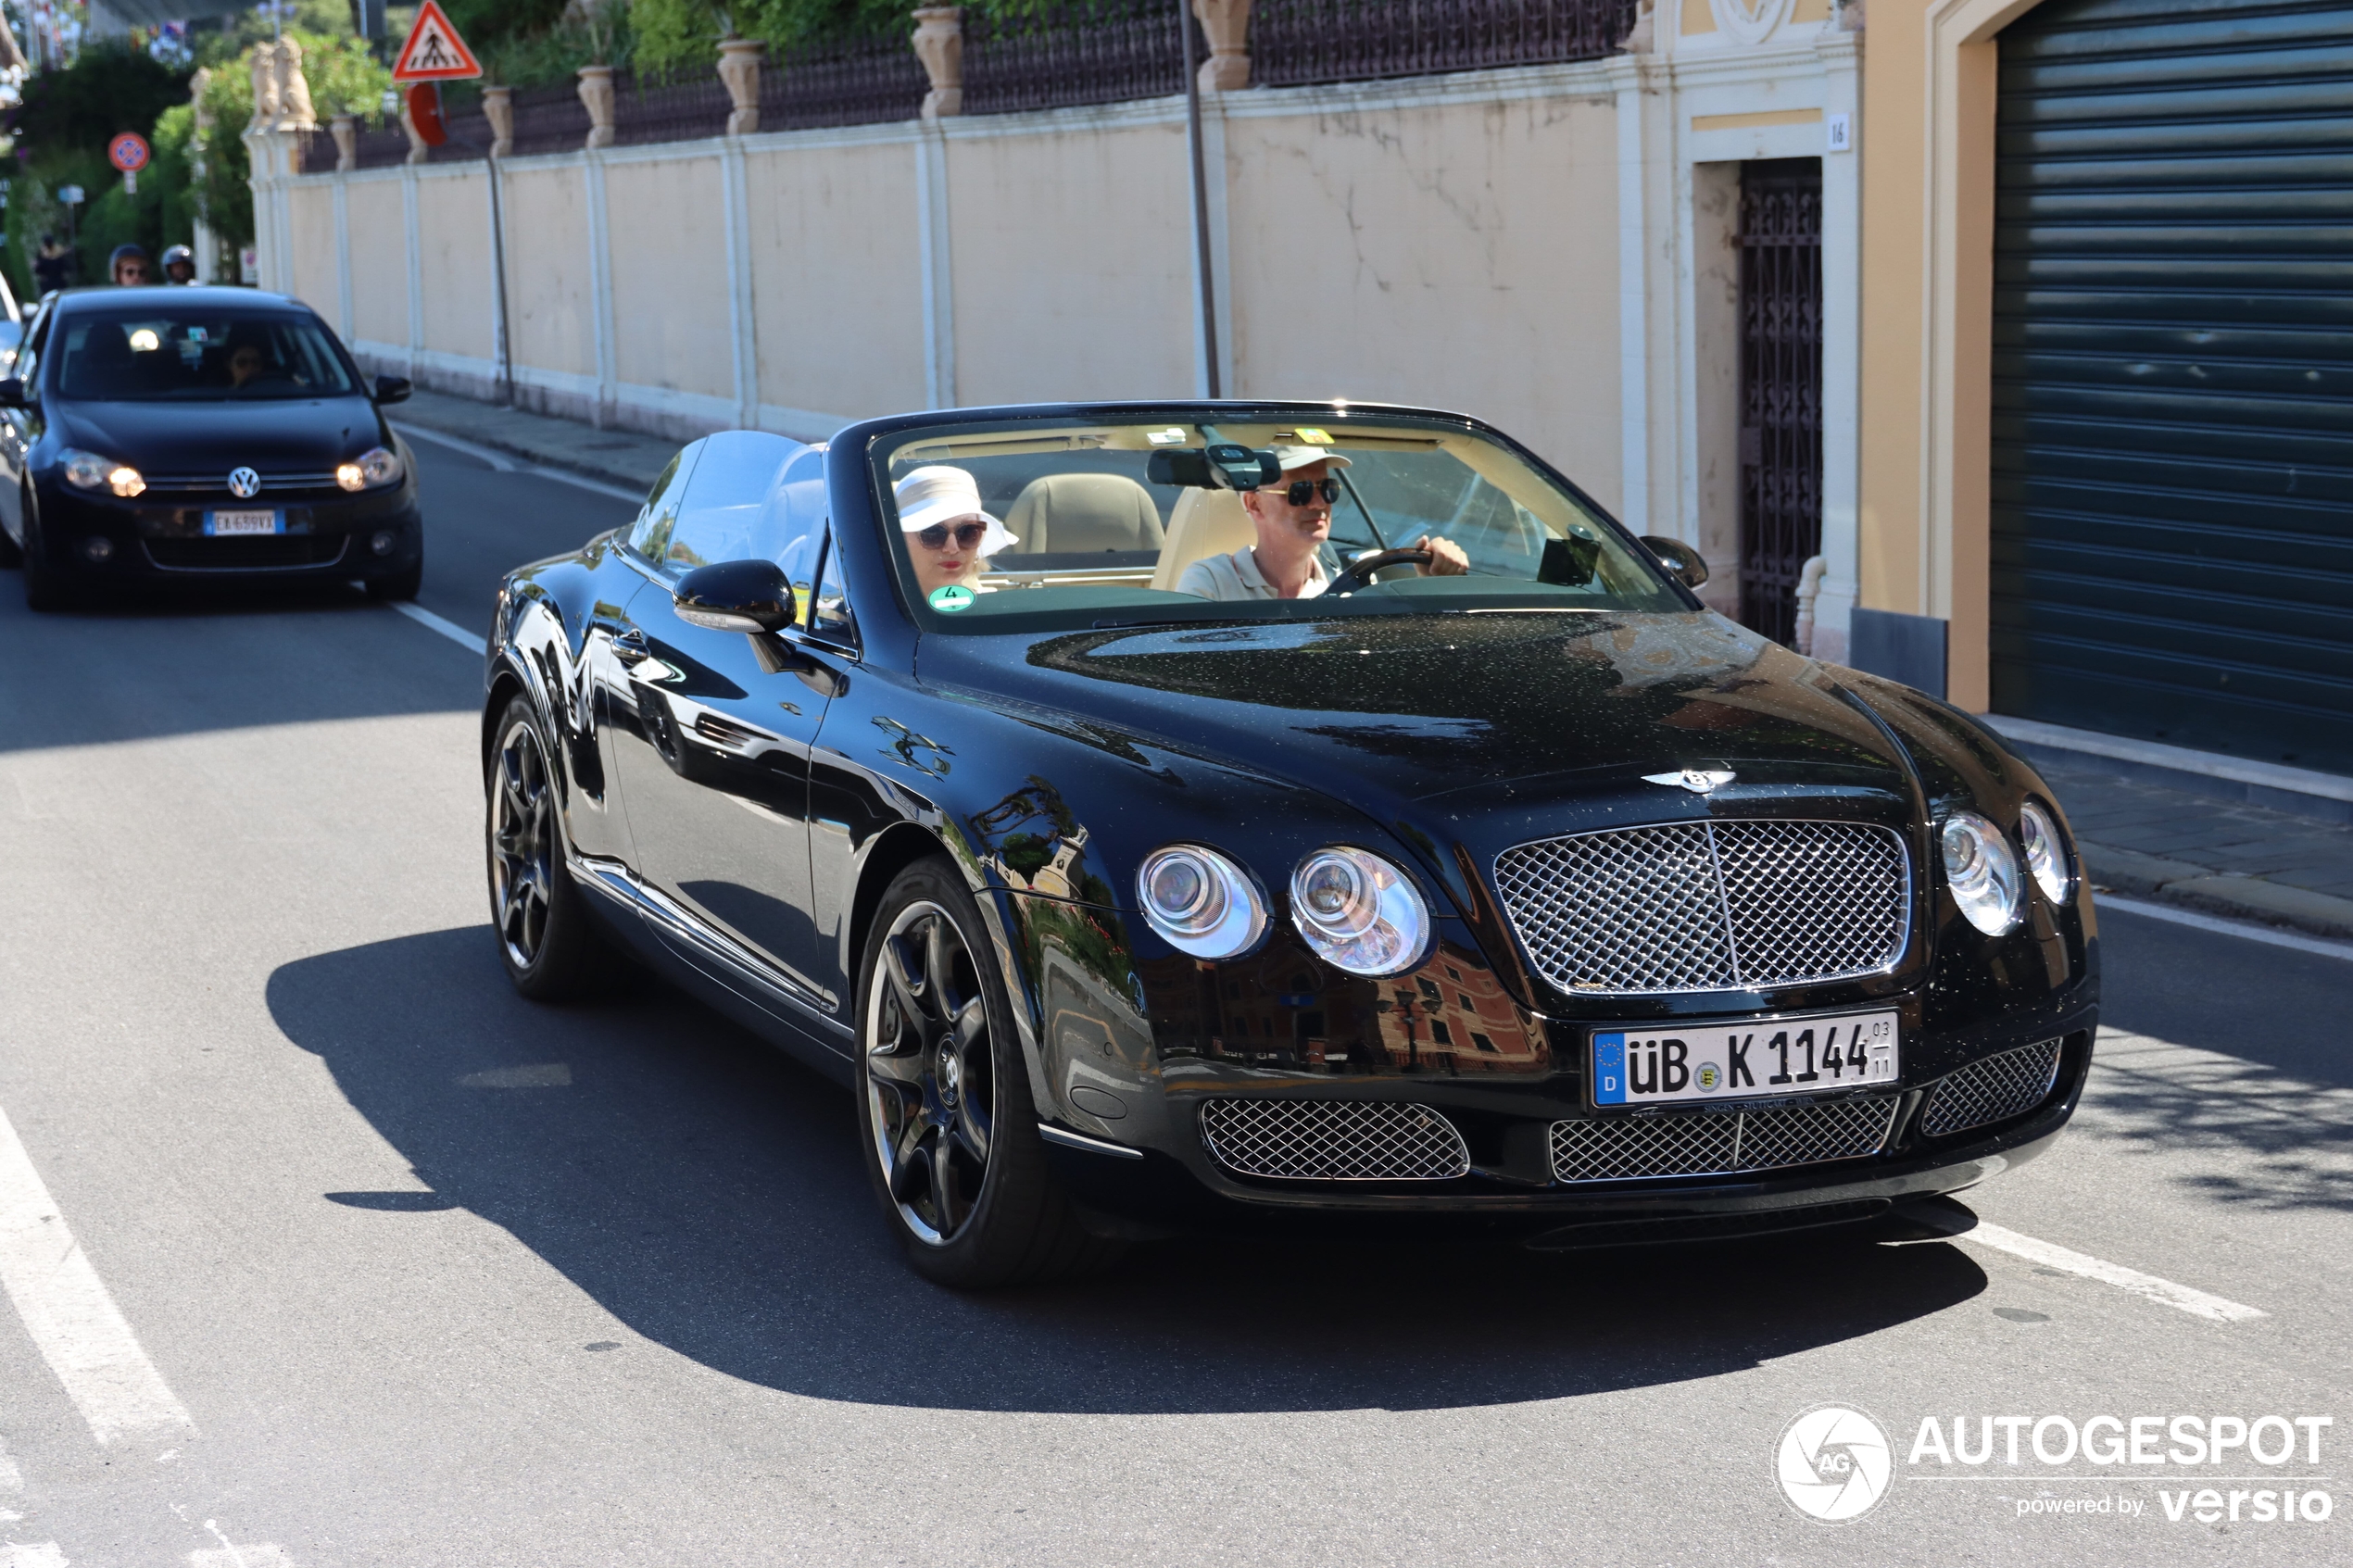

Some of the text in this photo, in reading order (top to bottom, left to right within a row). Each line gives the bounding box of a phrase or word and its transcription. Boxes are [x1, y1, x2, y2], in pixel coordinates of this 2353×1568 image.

[1832, 122, 1843, 144] 16
[945, 587, 957, 597] 4
[1873, 1022, 1890, 1036] 03
[1729, 1034, 1755, 1088] K
[1768, 1024, 1869, 1085] 1144
[1874, 1057, 1890, 1073] 11
[1604, 1076, 1616, 1092] D
[1704, 1102, 1734, 1113] SINGEN
